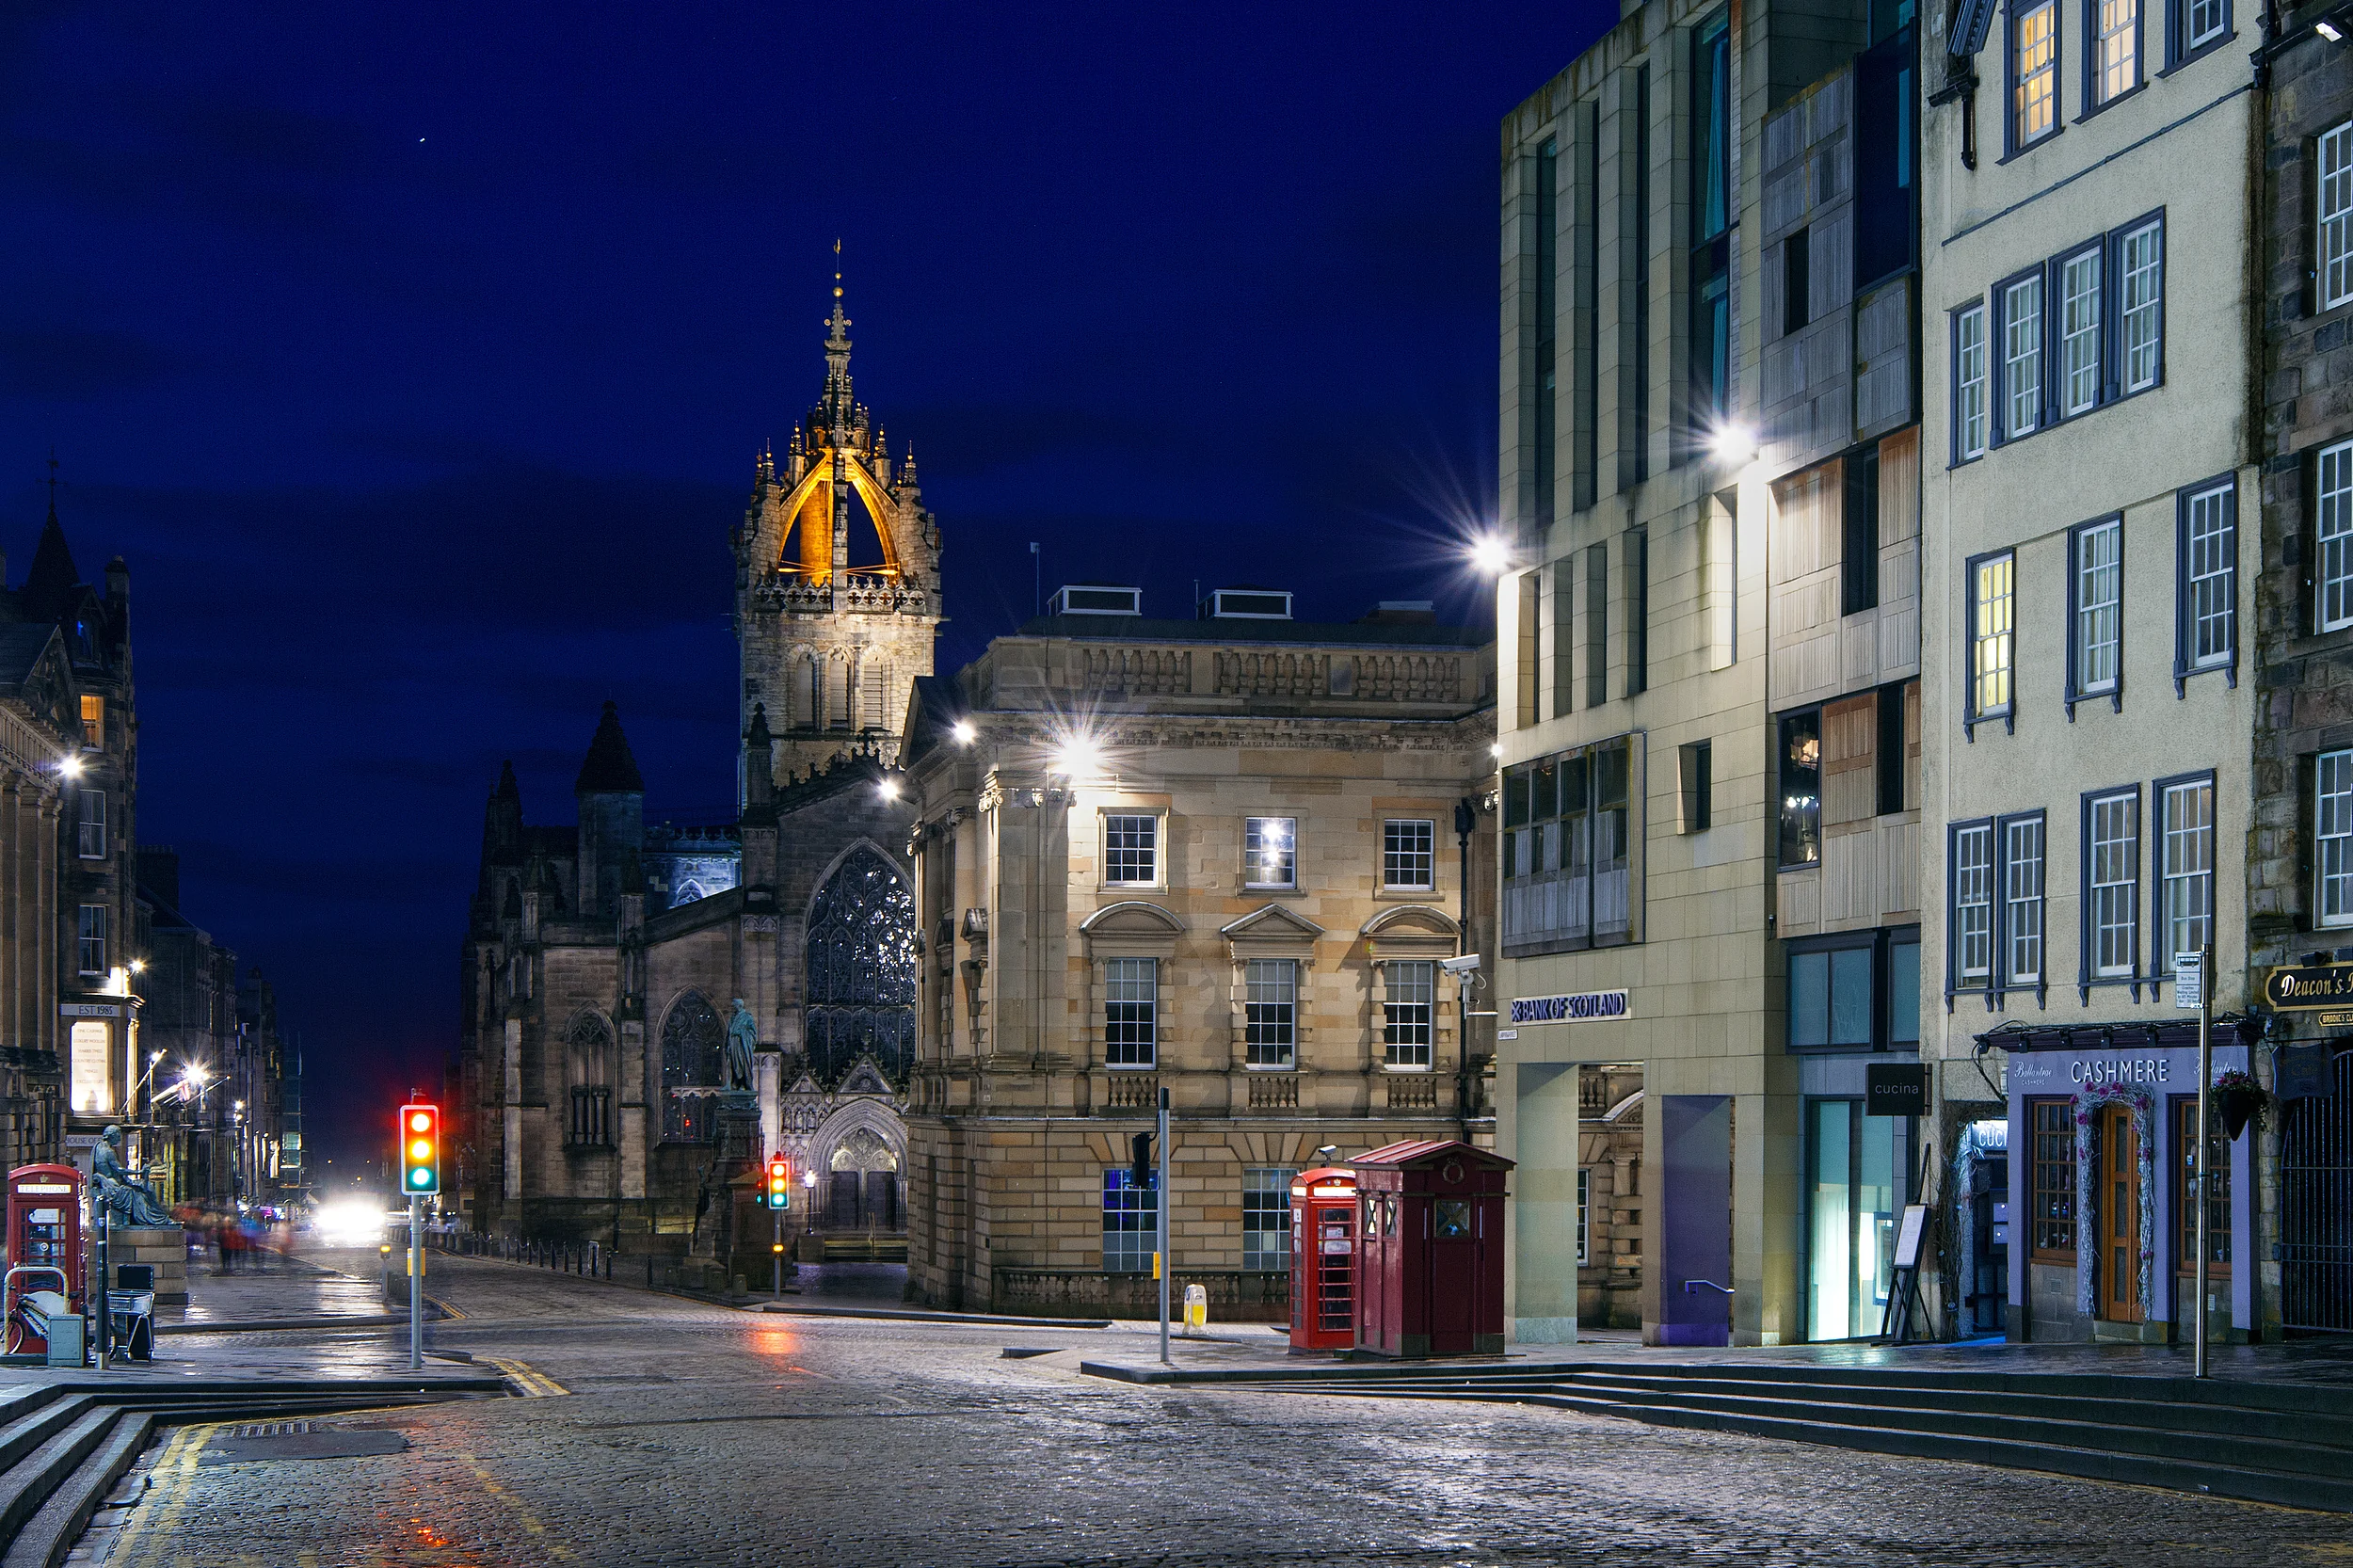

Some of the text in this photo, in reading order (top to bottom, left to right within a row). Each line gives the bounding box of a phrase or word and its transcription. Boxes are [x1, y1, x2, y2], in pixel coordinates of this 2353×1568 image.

[2281, 969, 2345, 998] Deacon's
[78, 1005, 113, 1015] EST 1985
[1522, 992, 1625, 1022] BANK OF SCOTLAND
[2071, 1059, 2169, 1083] CASHMERE
[1875, 1081, 1919, 1095] cucina
